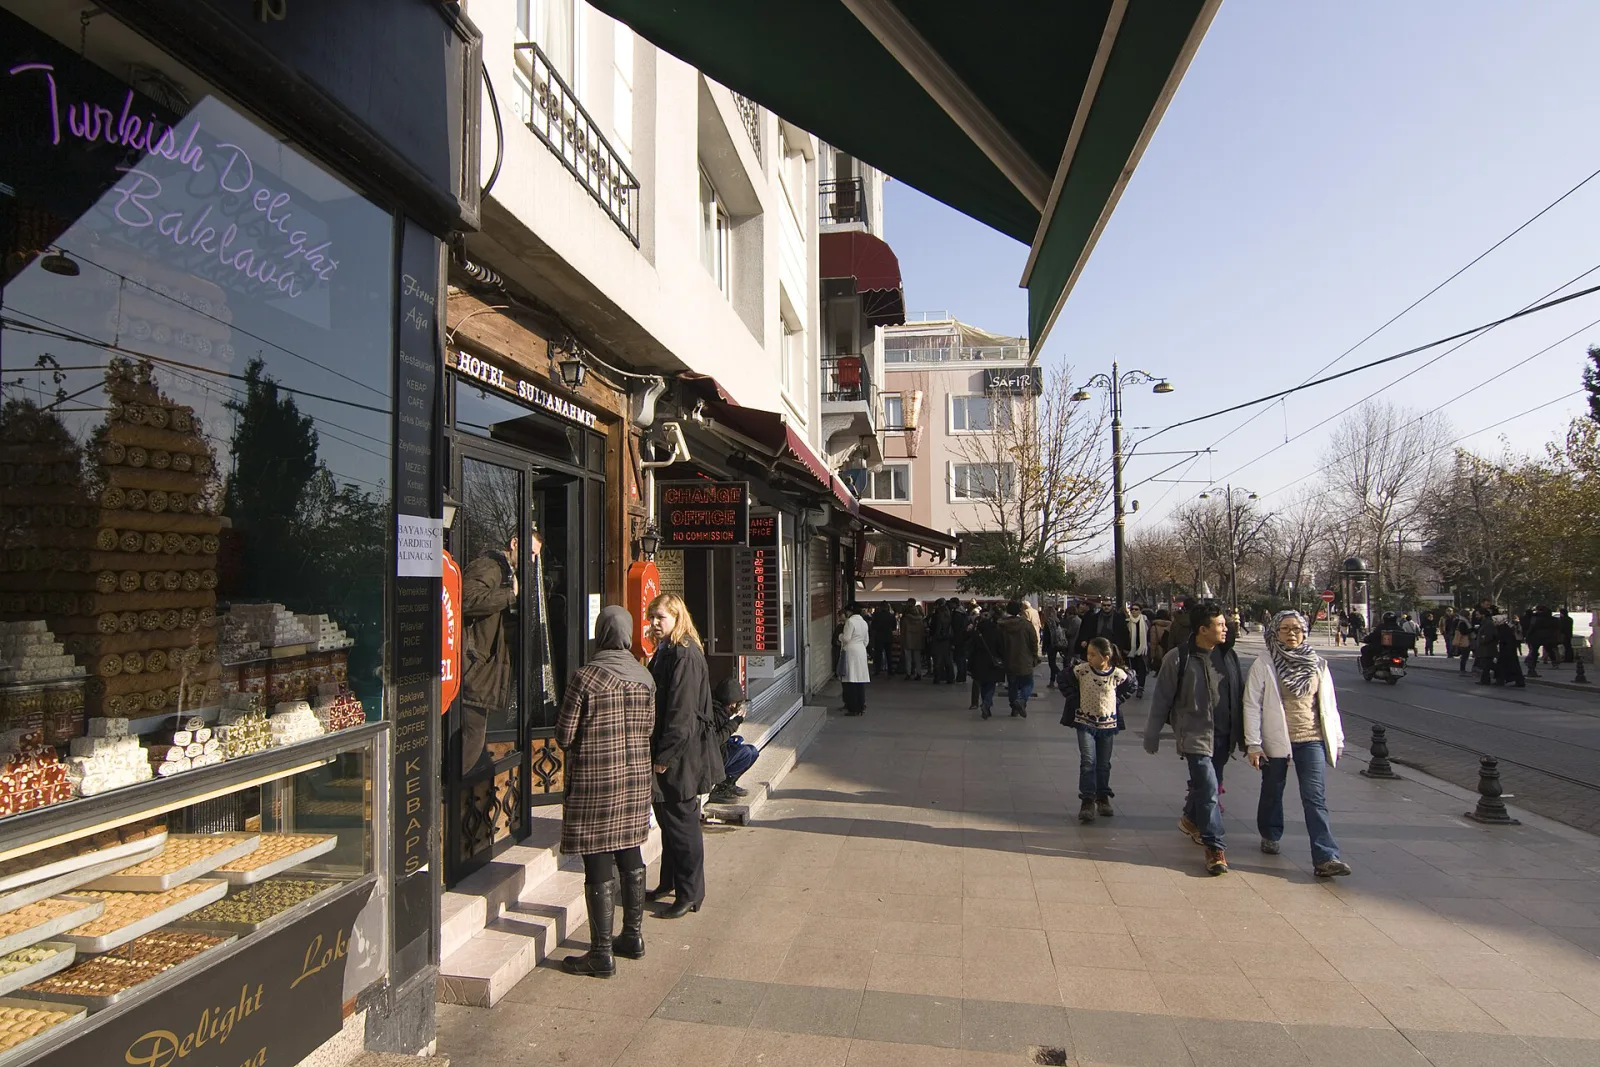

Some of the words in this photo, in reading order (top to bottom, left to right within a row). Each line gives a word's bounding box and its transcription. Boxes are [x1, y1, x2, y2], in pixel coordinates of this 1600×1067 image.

[9, 63, 205, 172] Turkish
[216, 143, 340, 281] Delight
[113, 165, 302, 298] Baklava
[402, 273, 435, 306] Firuz
[405, 306, 428, 330] Ağa
[406, 379, 427, 393] KEBAP
[457, 350, 506, 389] HOTEL
[517, 379, 597, 429] SULTANAHMET
[407, 396, 424, 409] CAFE
[664, 486, 742, 505] CHANGE
[670, 509, 736, 526] OFFICE
[673, 531, 684, 541] NO
[685, 531, 734, 541] COMMISSION
[403, 636, 420, 647] RICE
[396, 720, 425, 737] COFFEE
[405, 757, 421, 873] KEBAPS
[125, 983, 264, 1067] Delight
